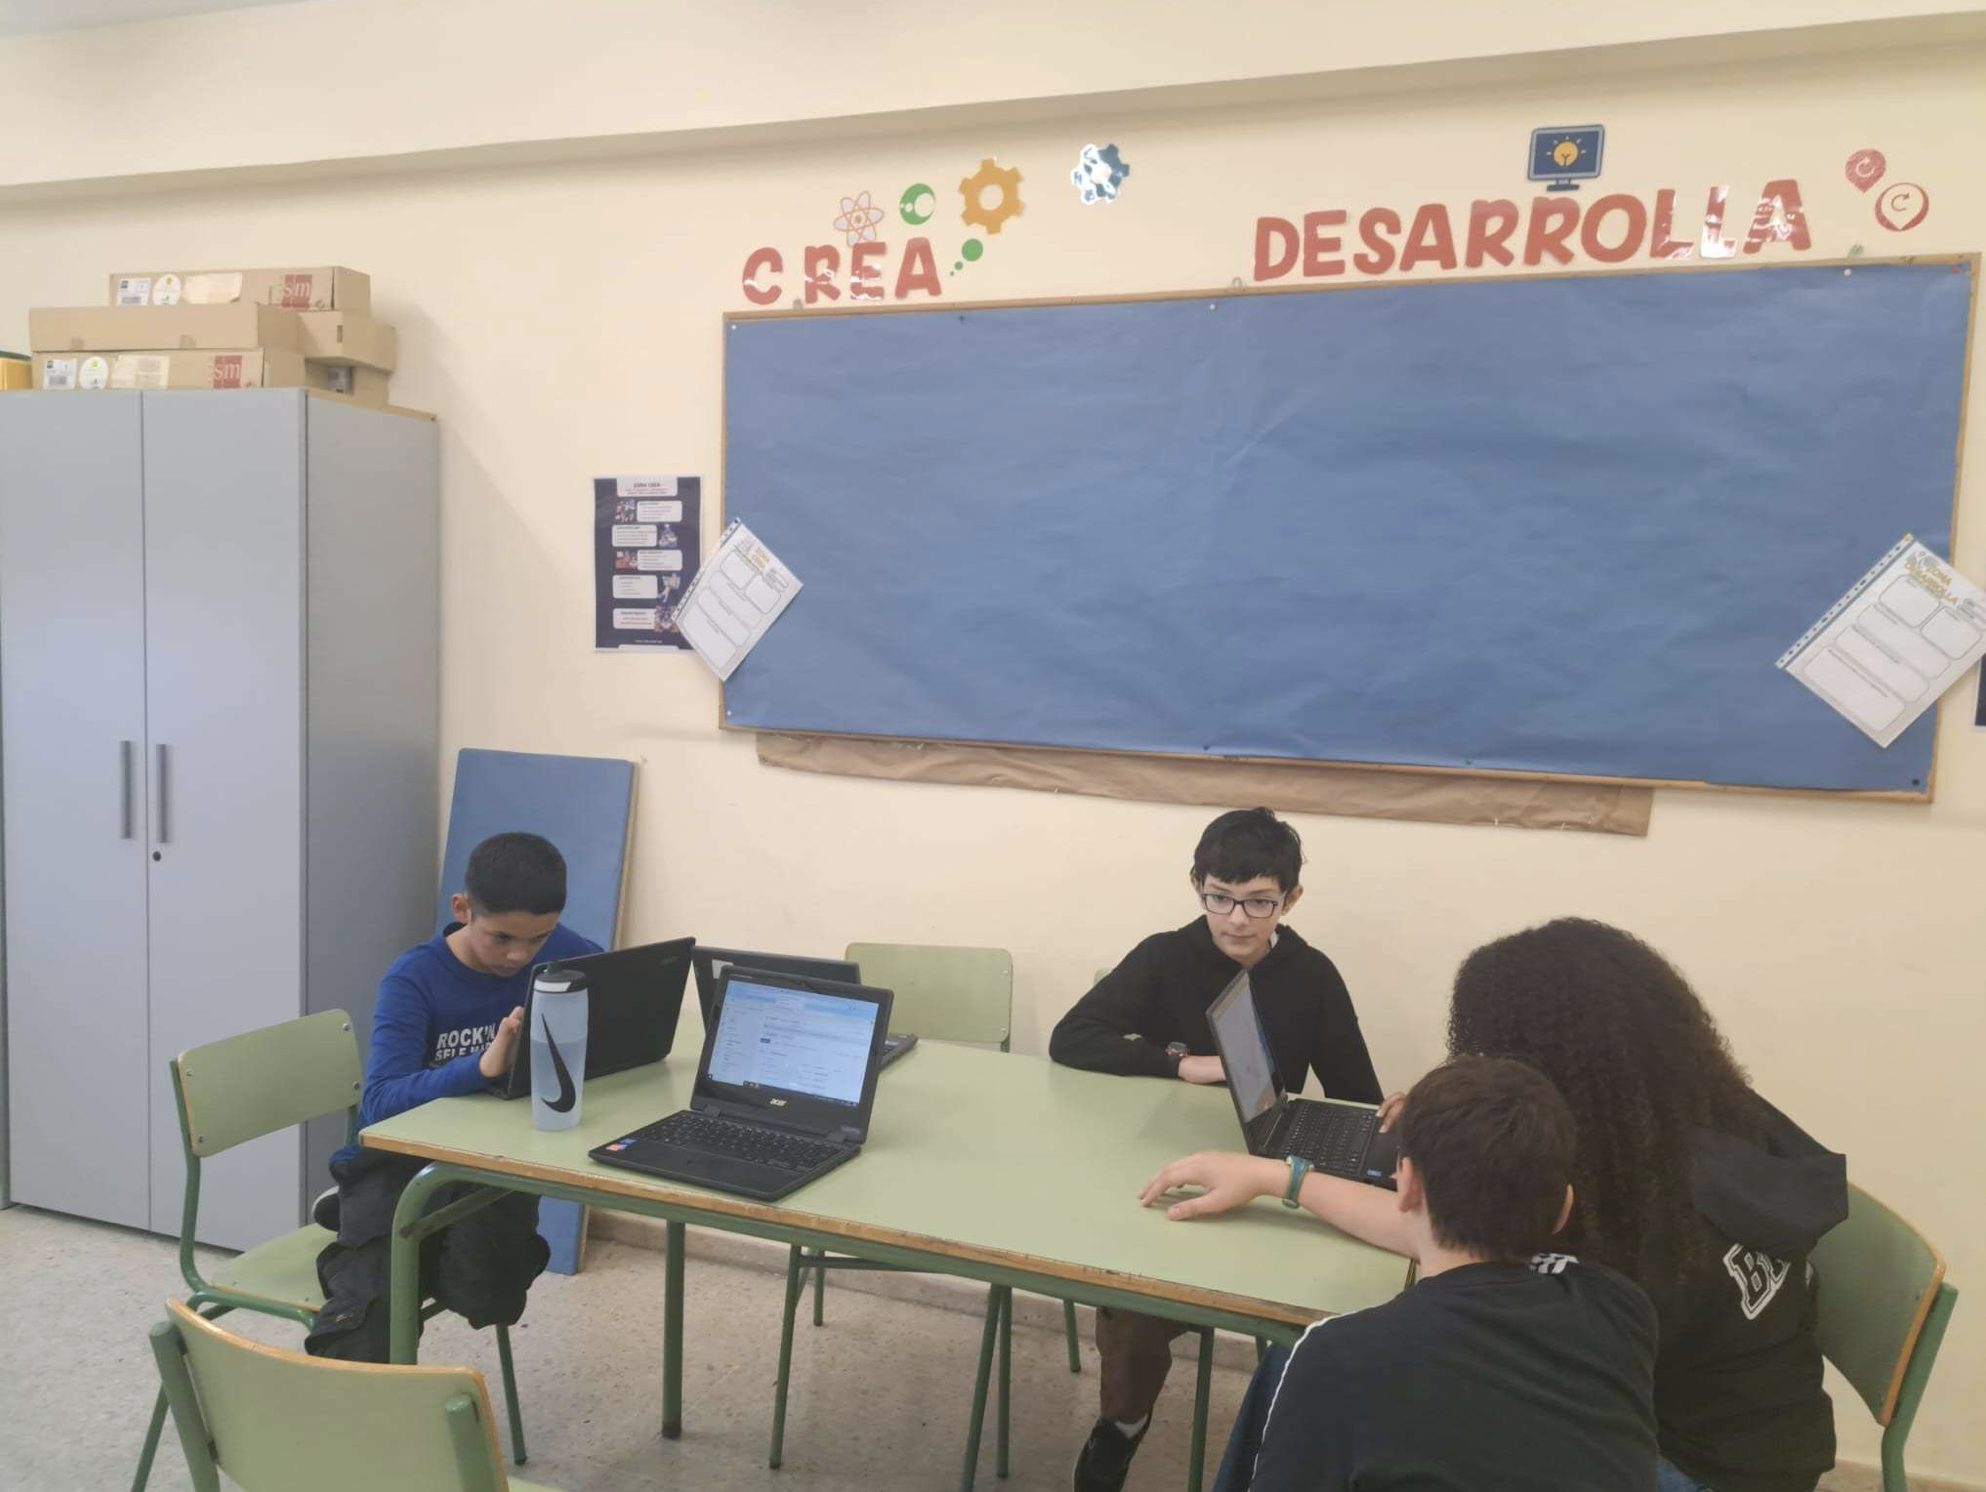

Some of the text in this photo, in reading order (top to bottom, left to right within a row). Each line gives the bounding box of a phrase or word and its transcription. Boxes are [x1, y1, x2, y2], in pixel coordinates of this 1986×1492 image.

[1253, 179, 1812, 282] DESARROLLA
[283, 282, 310, 298] sm
[742, 237, 942, 305] CREA
[214, 363, 240, 379] sm
